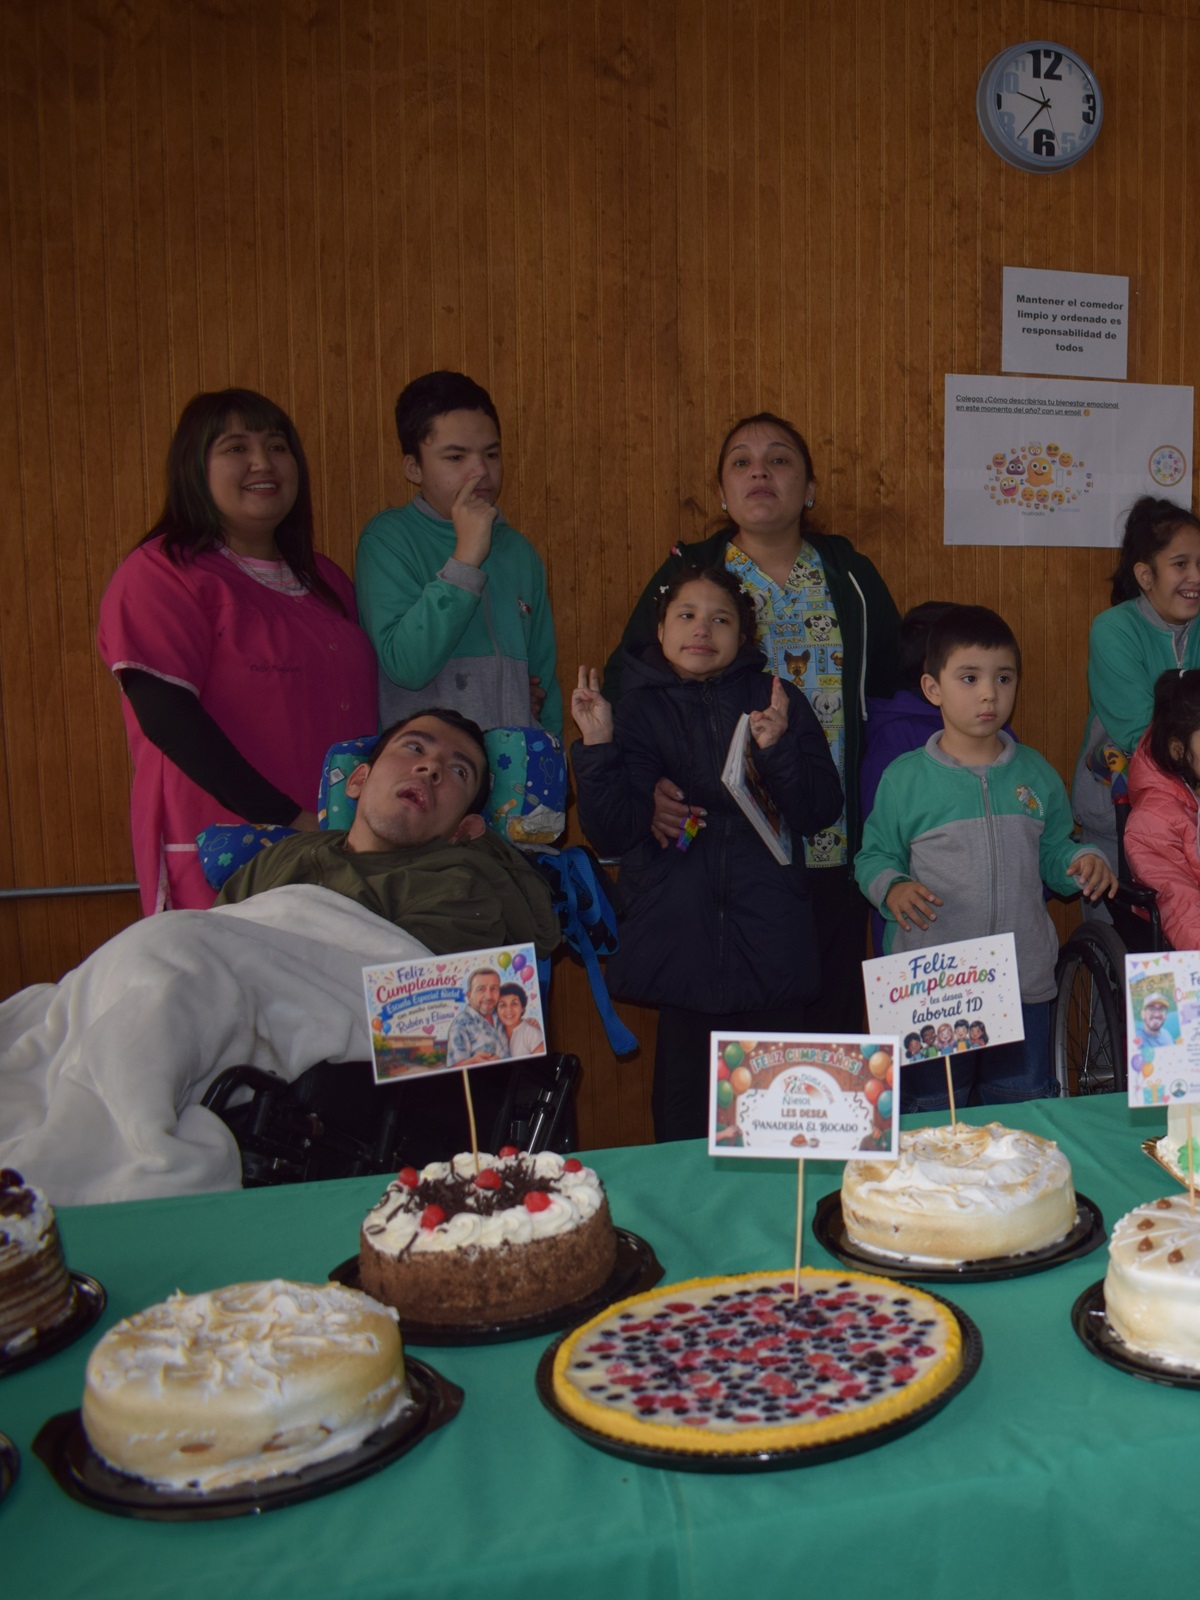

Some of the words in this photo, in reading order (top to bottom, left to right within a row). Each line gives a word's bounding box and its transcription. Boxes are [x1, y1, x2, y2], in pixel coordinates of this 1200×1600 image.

[1027, 48, 1063, 81] 12
[1082, 94, 1096, 125] 3
[1033, 129, 1055, 157] 6
[1016, 294, 1065, 306] Mantener
[1068, 299, 1077, 307] el
[1080, 301, 1123, 310] comedor
[1017, 310, 1049, 320] limpio
[1052, 314, 1057, 322] y
[1060, 314, 1107, 324] ordenado
[1022, 326, 1101, 339] responsabilidad
[1105, 331, 1117, 340] de
[1055, 343, 1084, 352] todos
[956, 394, 983, 403] Colegas
[1047, 398, 1055, 406] tu
[1055, 399, 1085, 408] bienestar
[1086, 401, 1119, 409] emocional
[1013, 406, 1024, 414] del
[1025, 407, 1041, 415] año?
[396, 964, 426, 983] Feliz
[908, 952, 958, 979] Feliz
[376, 973, 458, 1003] Cumpleaños
[889, 965, 996, 1003] cumpleaños
[386, 997, 412, 1014] Escuela
[412, 992, 440, 1007] Especial
[912, 1000, 963, 1024] laboral
[966, 996, 983, 1013] 1D
[396, 1016, 424, 1034] Rubén
[425, 1016, 430, 1025] y
[431, 1010, 455, 1022] Eliana
[749, 1050, 784, 1075] ¡FELIZ
[785, 1047, 864, 1076] CUMPLEAÑOS!
[781, 1108, 797, 1119] LES
[800, 1108, 828, 1119] DESEA
[752, 1120, 803, 1131] PANADERÍA
